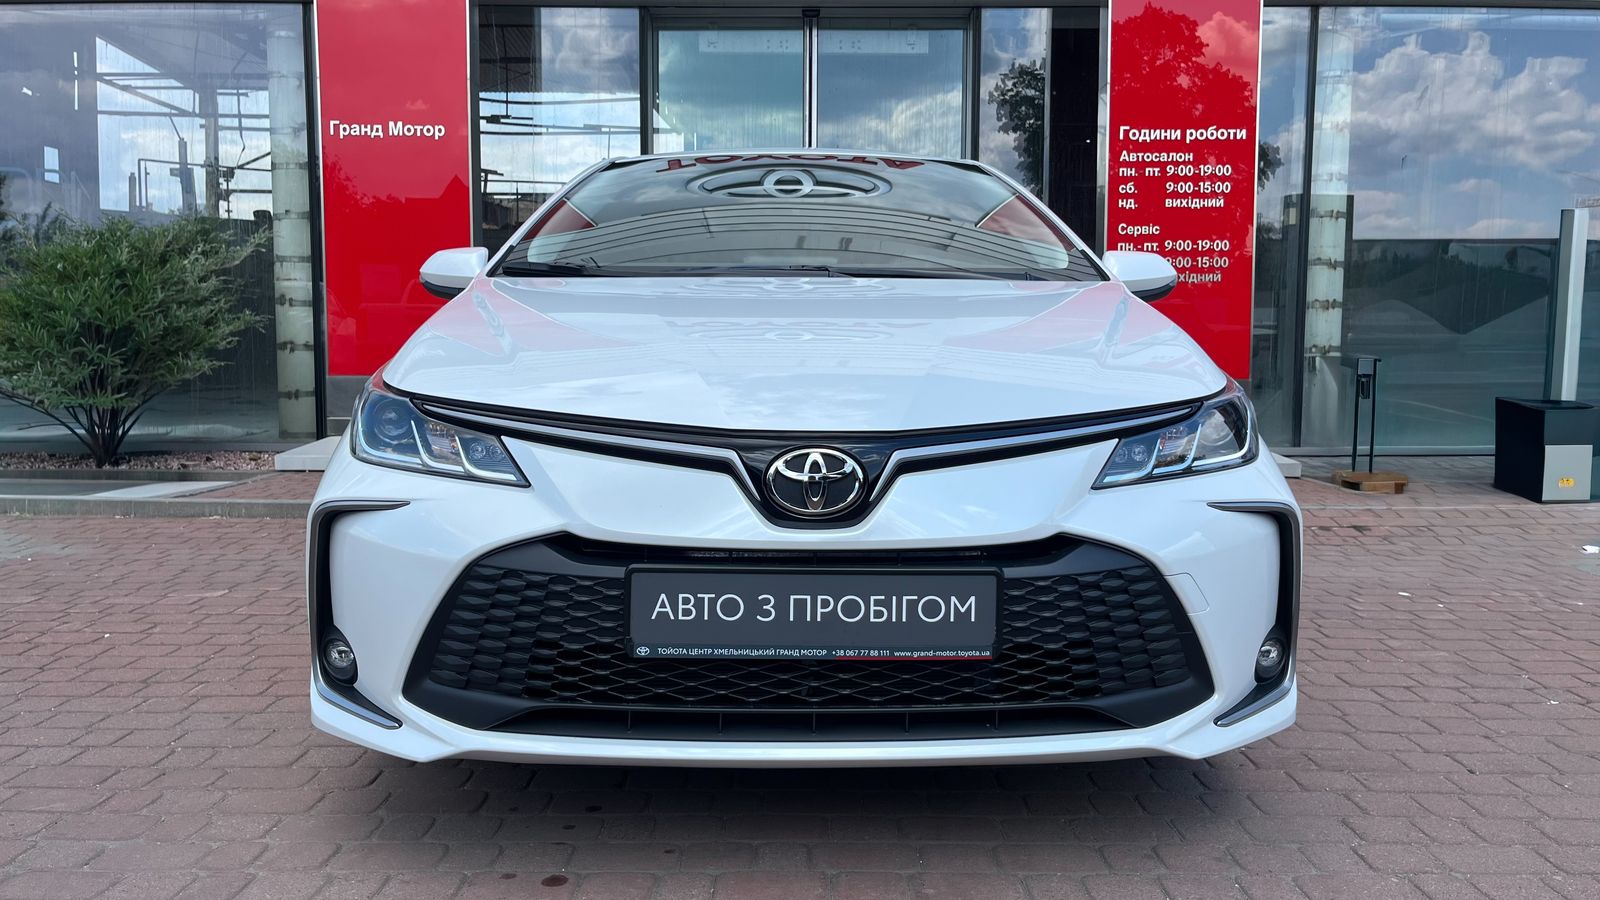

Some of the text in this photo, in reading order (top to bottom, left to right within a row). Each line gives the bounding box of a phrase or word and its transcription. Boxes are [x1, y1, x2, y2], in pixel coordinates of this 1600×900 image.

[329, 120, 446, 140] Гранд Мотор
[1119, 126, 1247, 143] Години роботи
[1119, 151, 1194, 162] Автосалон
[1166, 164, 1232, 177] 9:00-19:00
[1118, 181, 1231, 194] сб. 9:00-15:00
[1118, 196, 1225, 209] нд. вихідний
[1118, 223, 1161, 237] Сервіс
[1164, 239, 1230, 252] 9:00-19:00
[1177, 271, 1222, 283] хідний
[650, 593, 745, 622] АВТО
[788, 595, 977, 623] ПРОБІГОМ
[657, 647, 991, 658] ТОЙОТА ЦЕНТР ХМЕЛЬНИЦЬКИЙ ГРАНД МОТОР +38 067 77 88 111 www.grand-motor.toyota.ua
